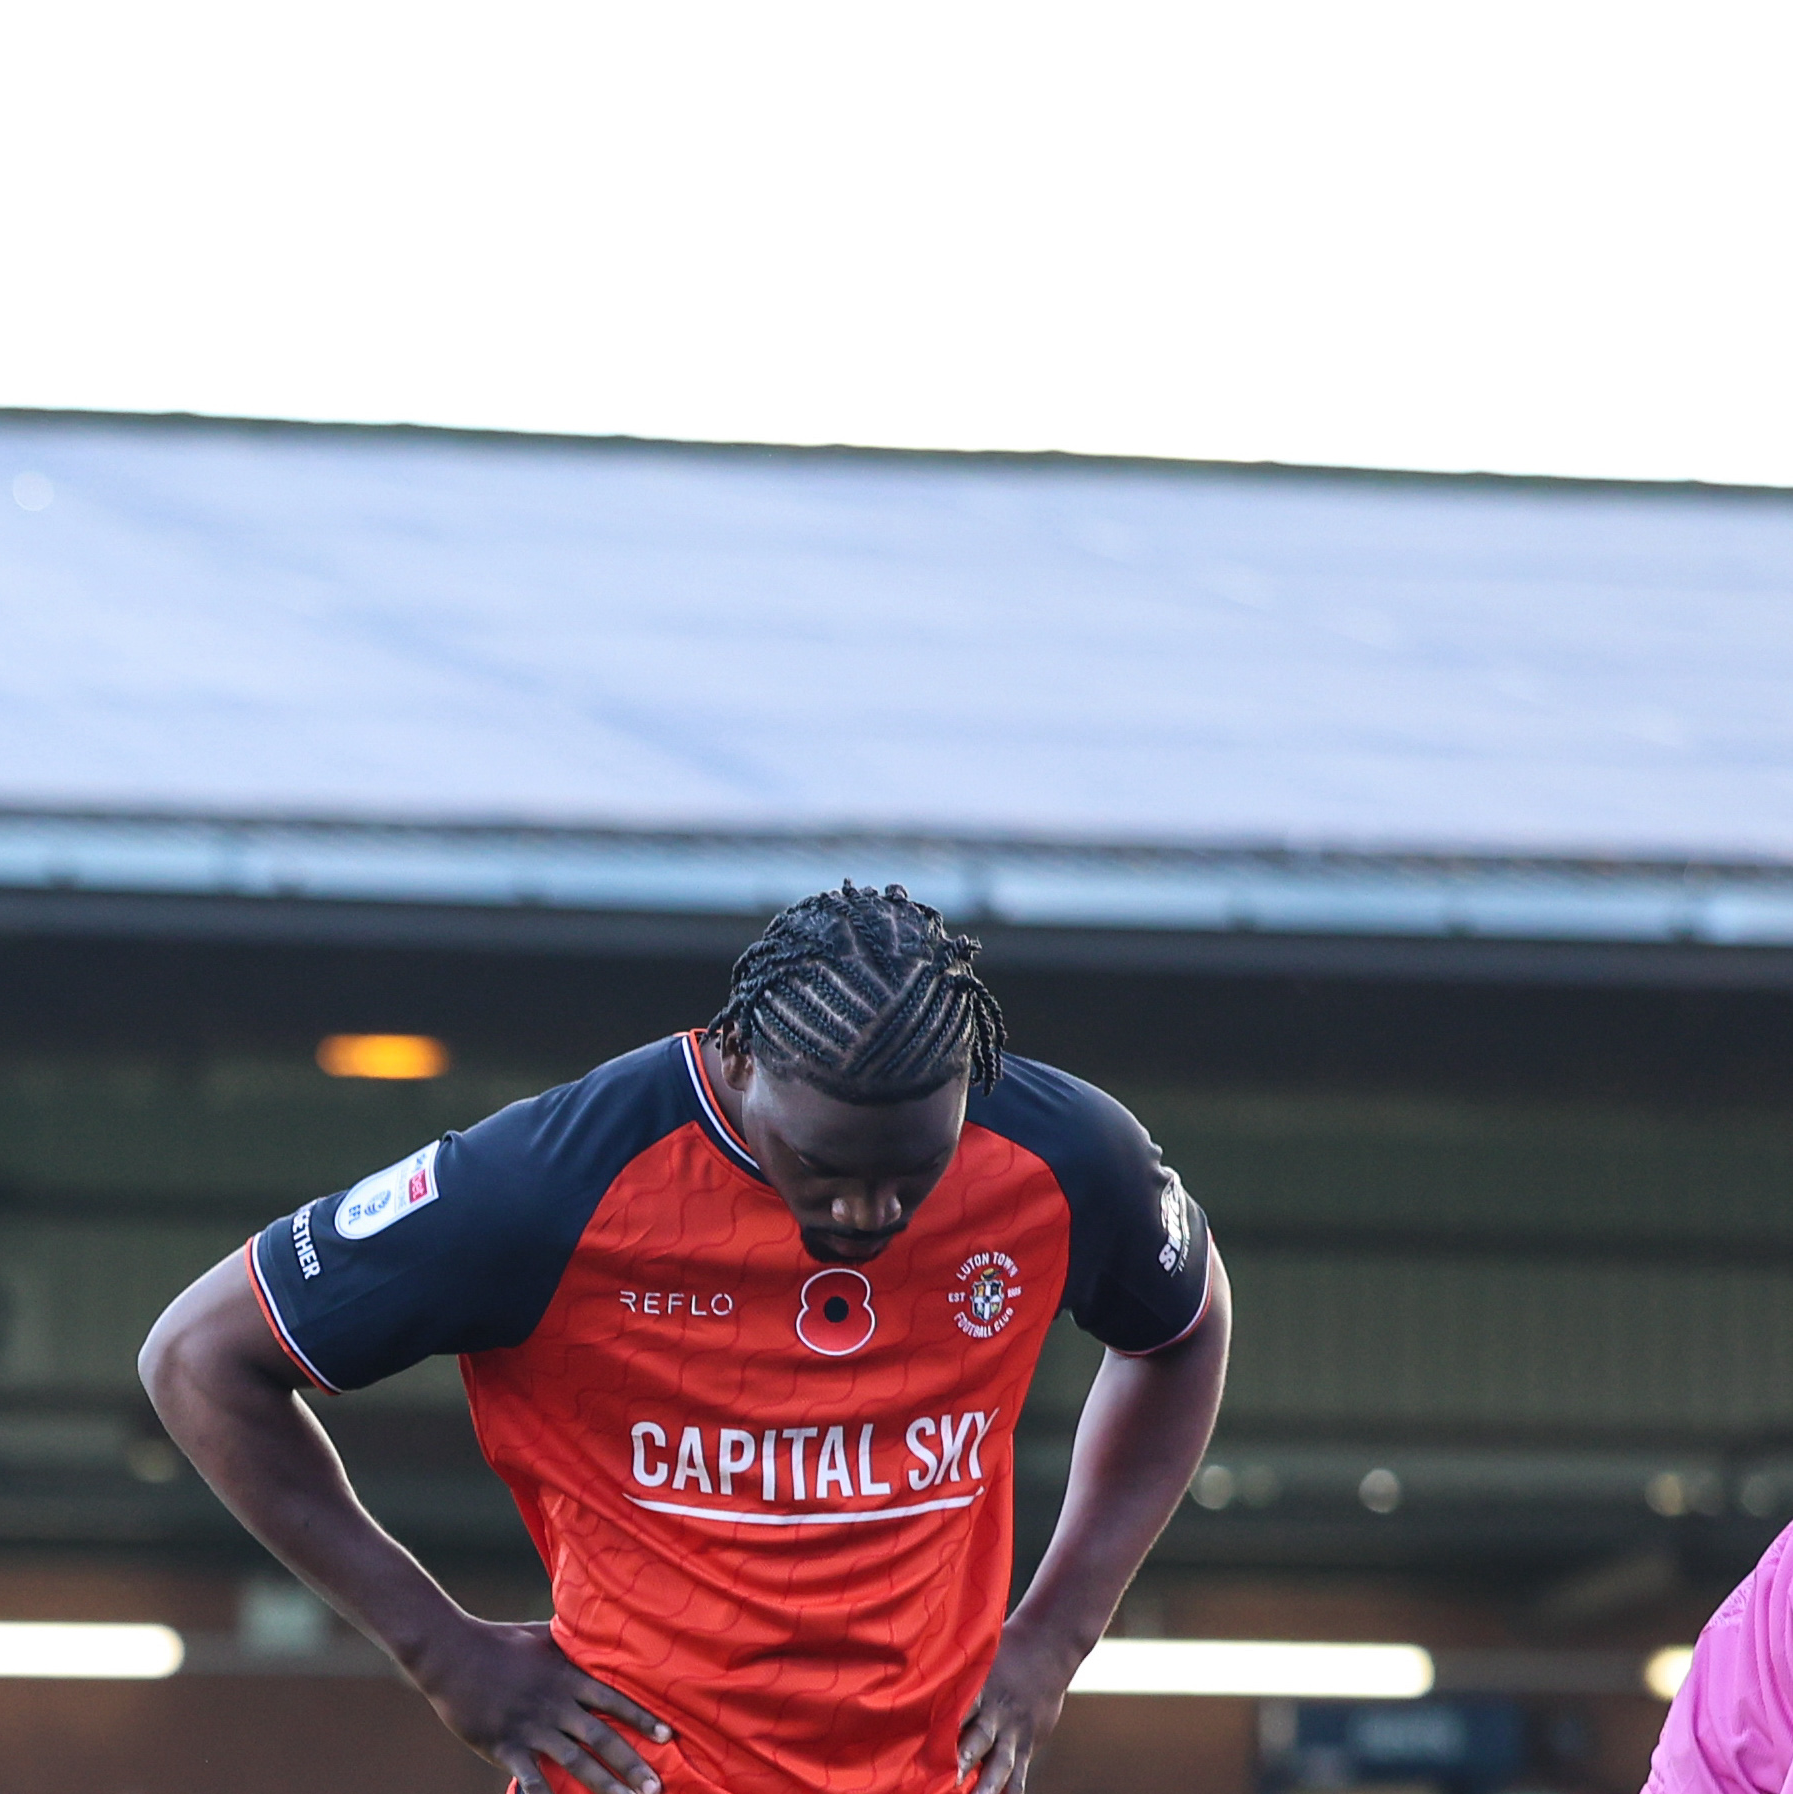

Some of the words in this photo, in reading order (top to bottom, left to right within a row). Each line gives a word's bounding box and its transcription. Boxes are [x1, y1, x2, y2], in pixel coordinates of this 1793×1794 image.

[956, 1252, 990, 1281] LUTON
[992, 1251, 1019, 1278] TOWN
[619, 1289, 735, 1317] REFLO
[993, 1307, 1014, 1332] CLUB
[630, 1420, 893, 1502] CAPITAL
[904, 1406, 1000, 1492] SKY
